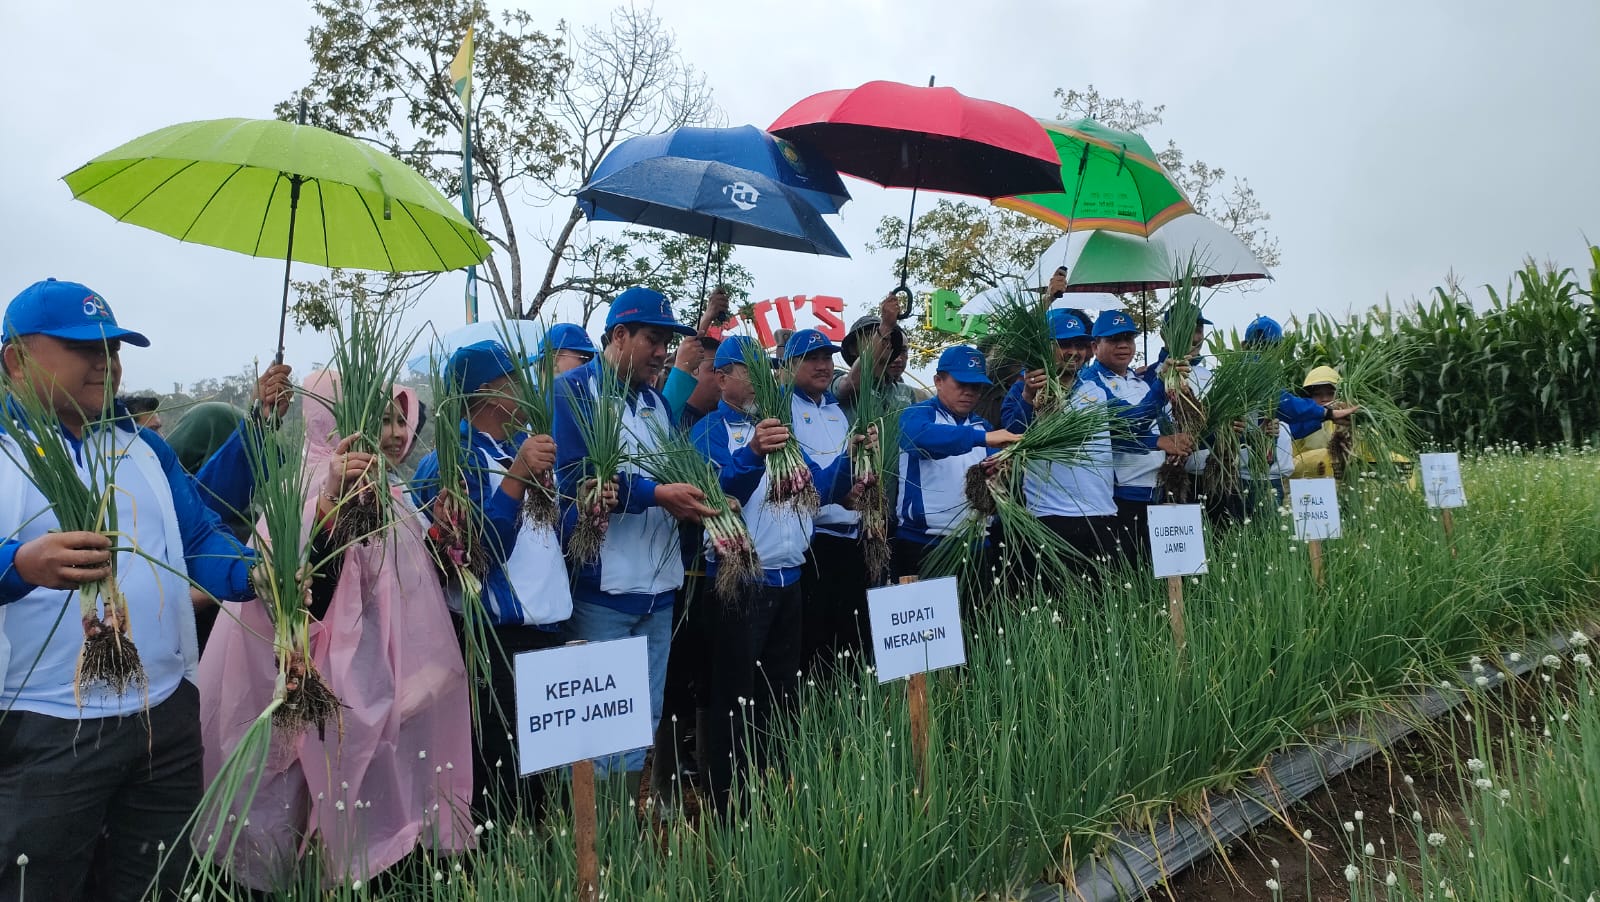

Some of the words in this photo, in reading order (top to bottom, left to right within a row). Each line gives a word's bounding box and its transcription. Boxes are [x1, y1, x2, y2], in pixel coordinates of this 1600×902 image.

[1154, 525, 1195, 538] GUBERNUR
[1164, 542, 1187, 554] JAMBI
[891, 607, 934, 625] BUPATI
[884, 626, 946, 650] MERANGIN
[546, 674, 616, 700] KEPALA
[530, 709, 576, 732] BPTP
[582, 698, 633, 721] JAMBI
